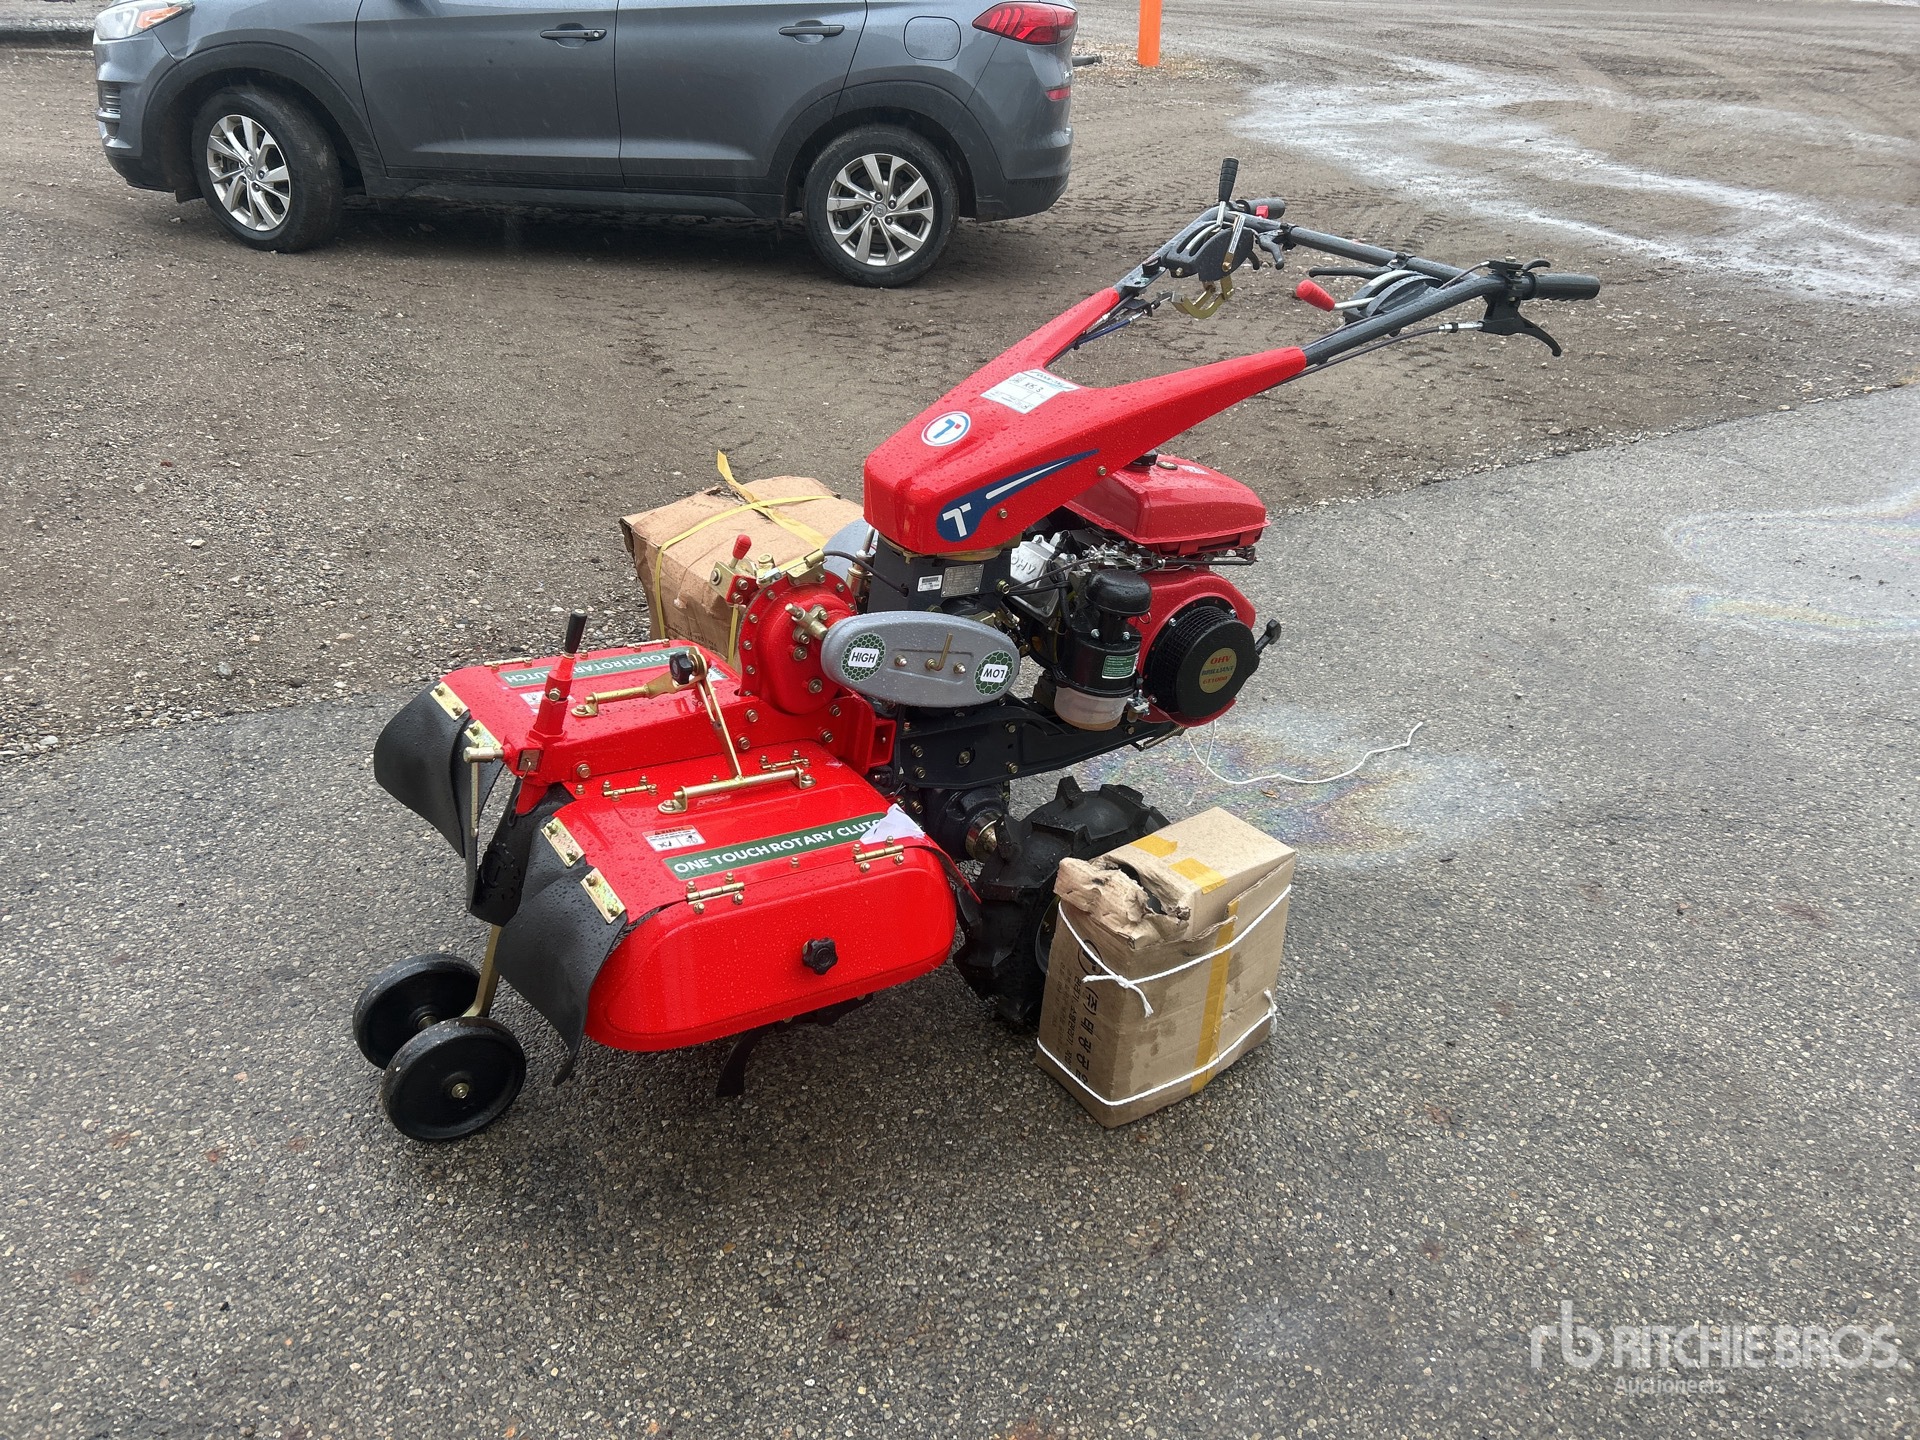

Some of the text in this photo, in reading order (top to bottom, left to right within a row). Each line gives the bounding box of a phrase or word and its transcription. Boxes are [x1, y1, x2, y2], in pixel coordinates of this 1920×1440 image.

[1011, 555, 1037, 575] OHV
[851, 651, 878, 664] HIGH
[1210, 655, 1232, 665] OHV
[504, 653, 671, 683] TOUCH ROTAR UTCH
[982, 667, 1005, 679] LOW
[674, 819, 881, 874] ONE TOUCH ROTARY CLUT
